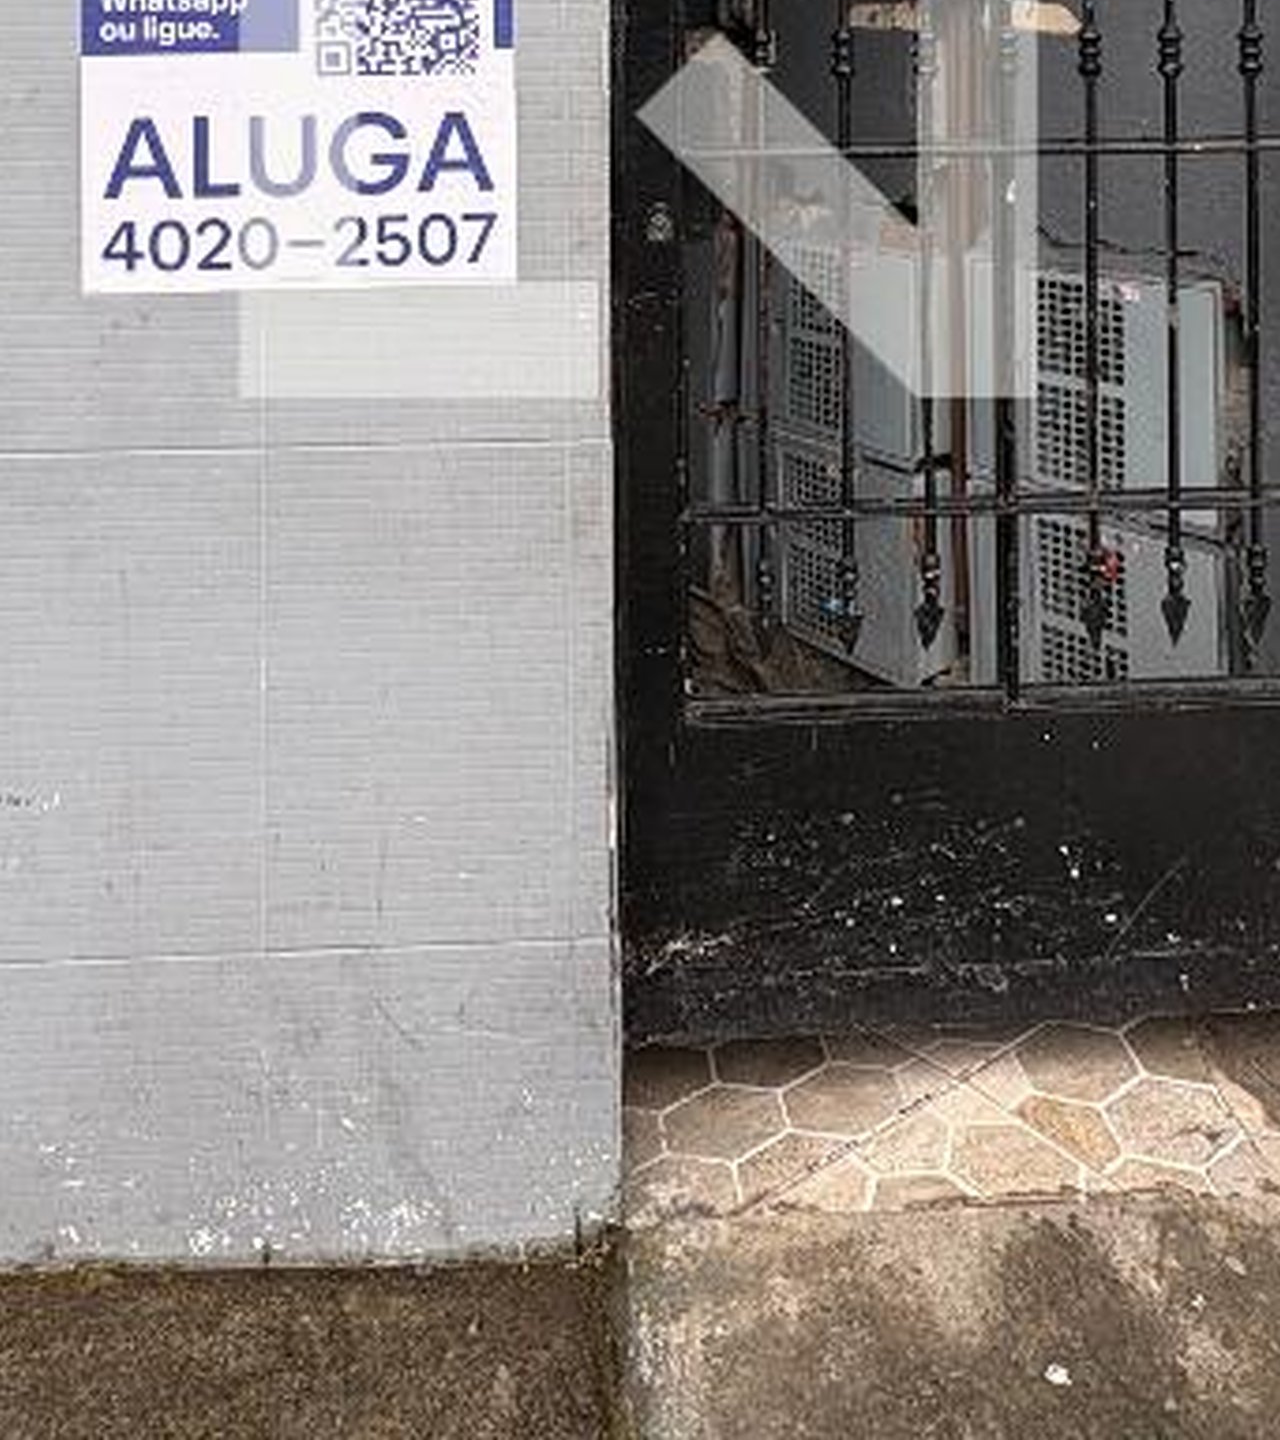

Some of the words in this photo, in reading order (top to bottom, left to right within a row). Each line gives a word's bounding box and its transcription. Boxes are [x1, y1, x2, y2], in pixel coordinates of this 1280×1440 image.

[99, 21, 135, 42] ou
[143, 17, 220, 44] ligue.
[102, 110, 496, 201] ALUGA
[101, 212, 499, 272] 4020-2507
